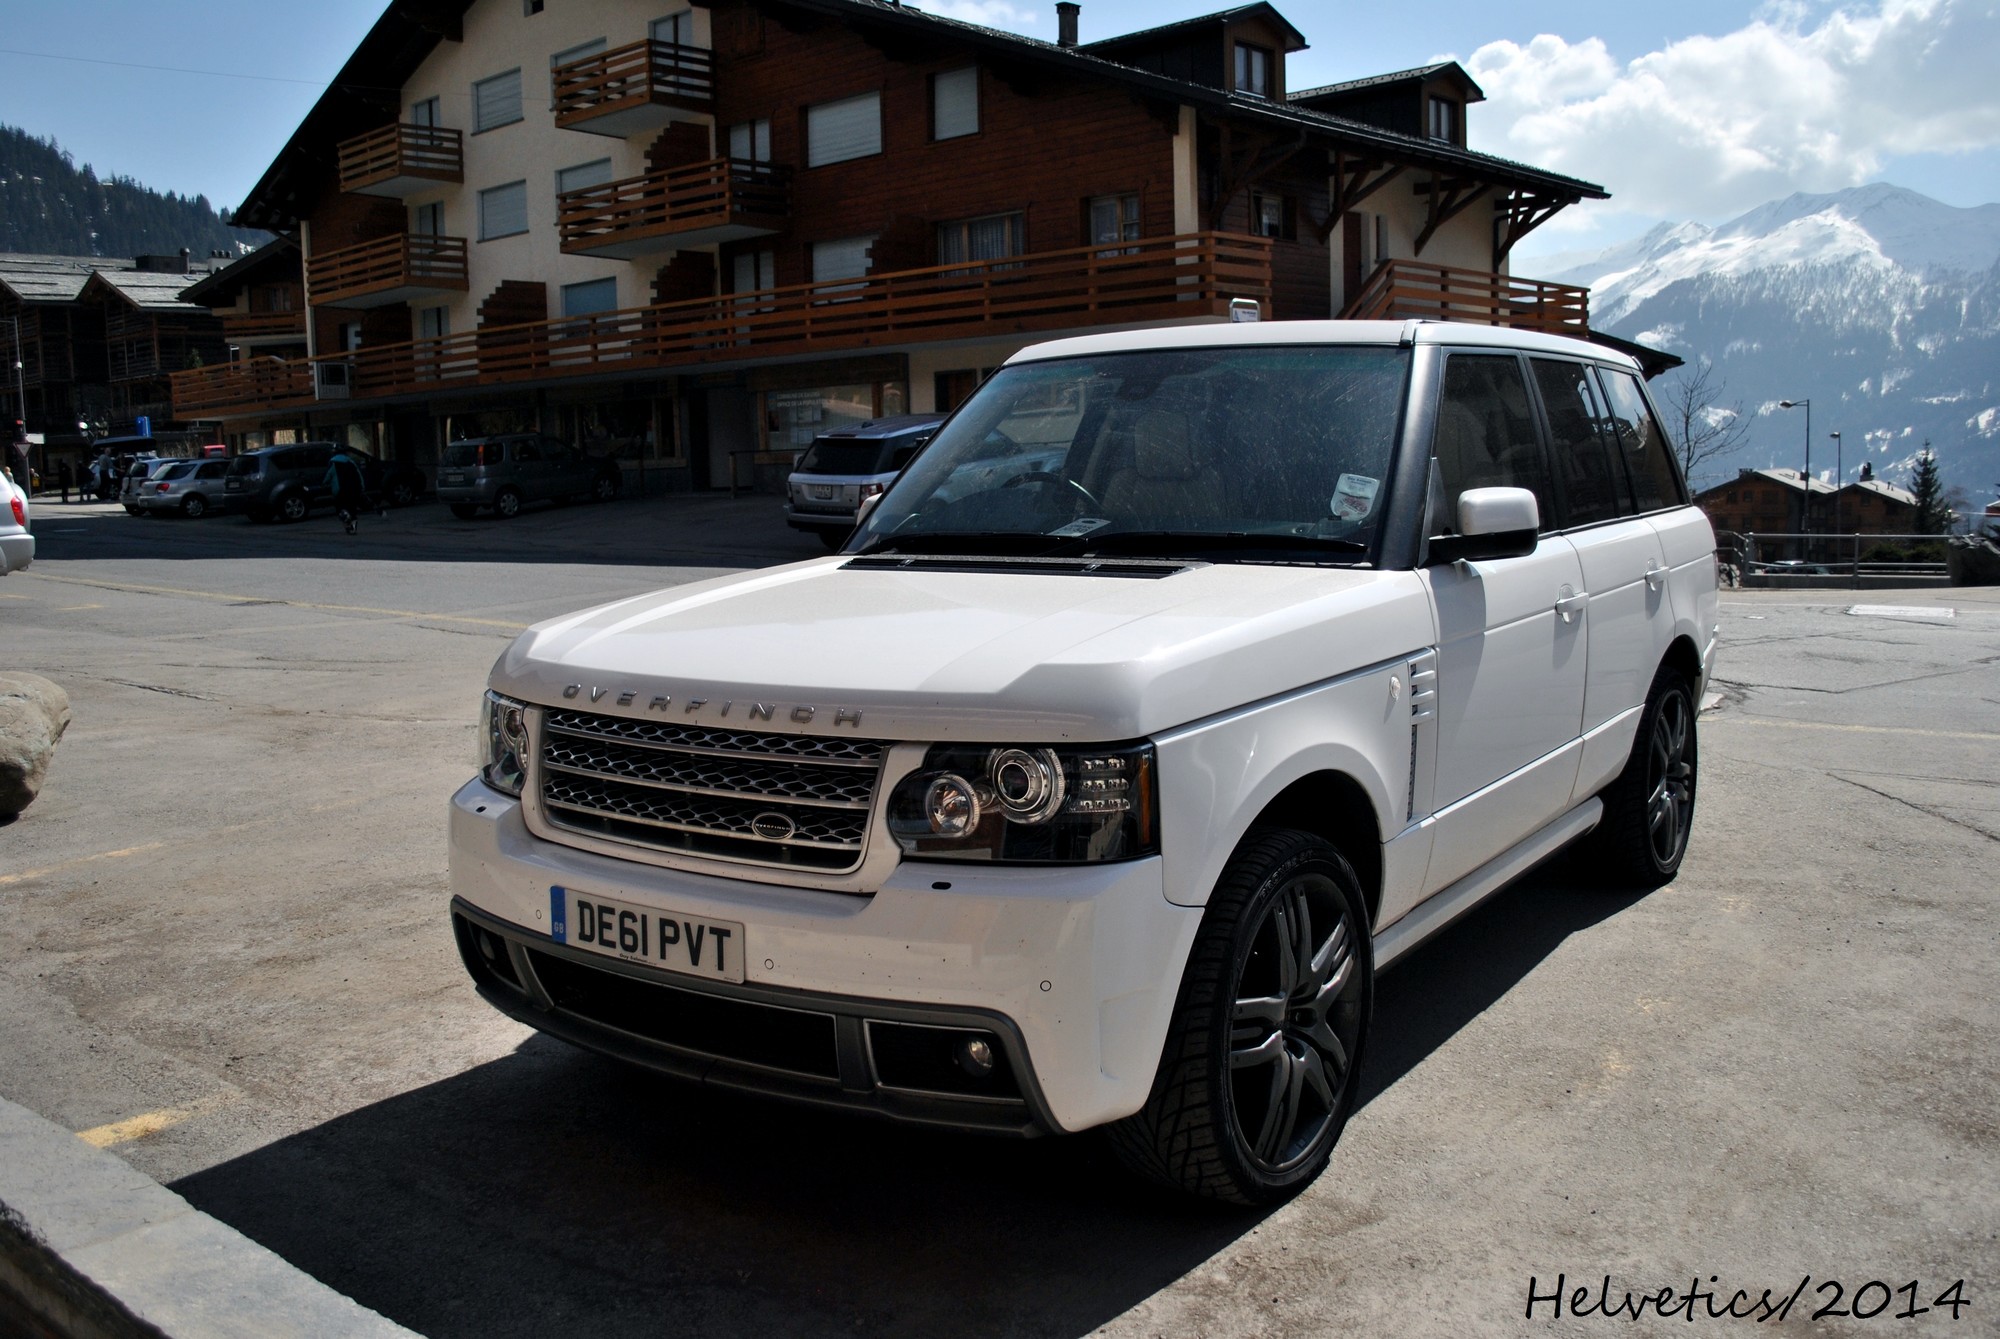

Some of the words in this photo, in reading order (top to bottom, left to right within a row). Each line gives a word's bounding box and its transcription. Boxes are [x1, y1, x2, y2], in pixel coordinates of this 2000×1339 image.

[562, 683, 864, 728] OVERFINCH
[554, 921, 564, 934] GB
[577, 900, 648, 956] DE61
[659, 917, 731, 971] PVT
